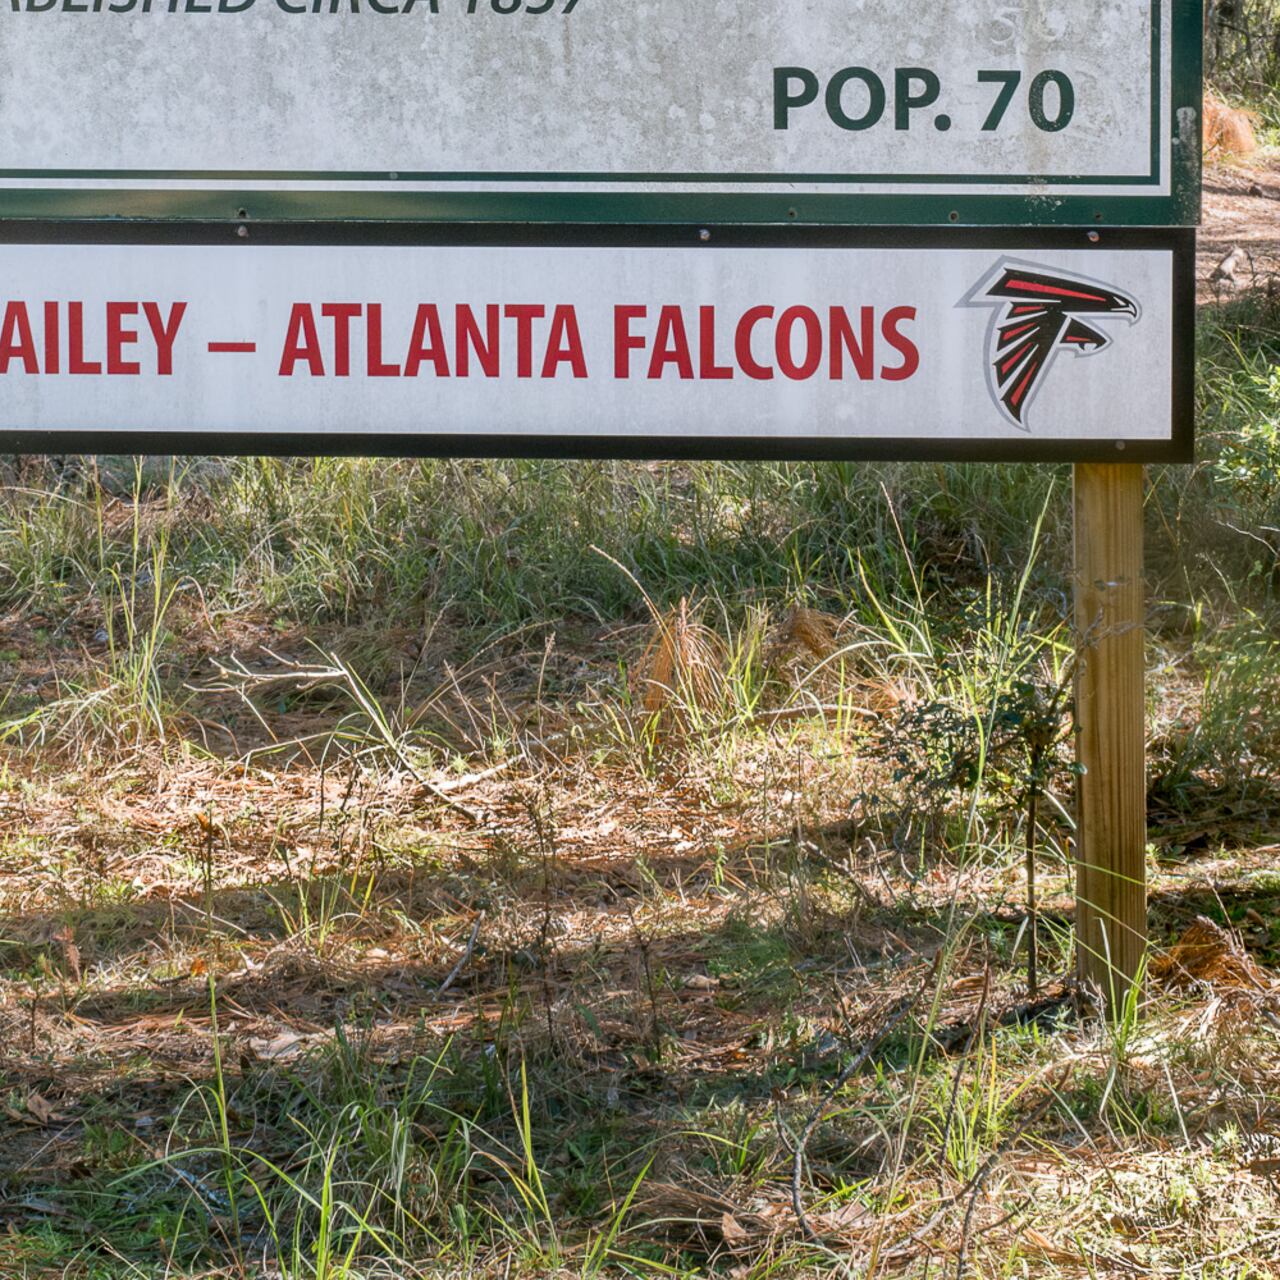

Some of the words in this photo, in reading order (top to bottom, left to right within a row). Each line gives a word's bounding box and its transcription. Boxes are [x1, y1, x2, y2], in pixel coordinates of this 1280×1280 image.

[774, 67, 951, 131] POP.
[978, 70, 1075, 132] 70
[280, 304, 587, 378] ATLANTA
[615, 305, 918, 381] FALCONS
